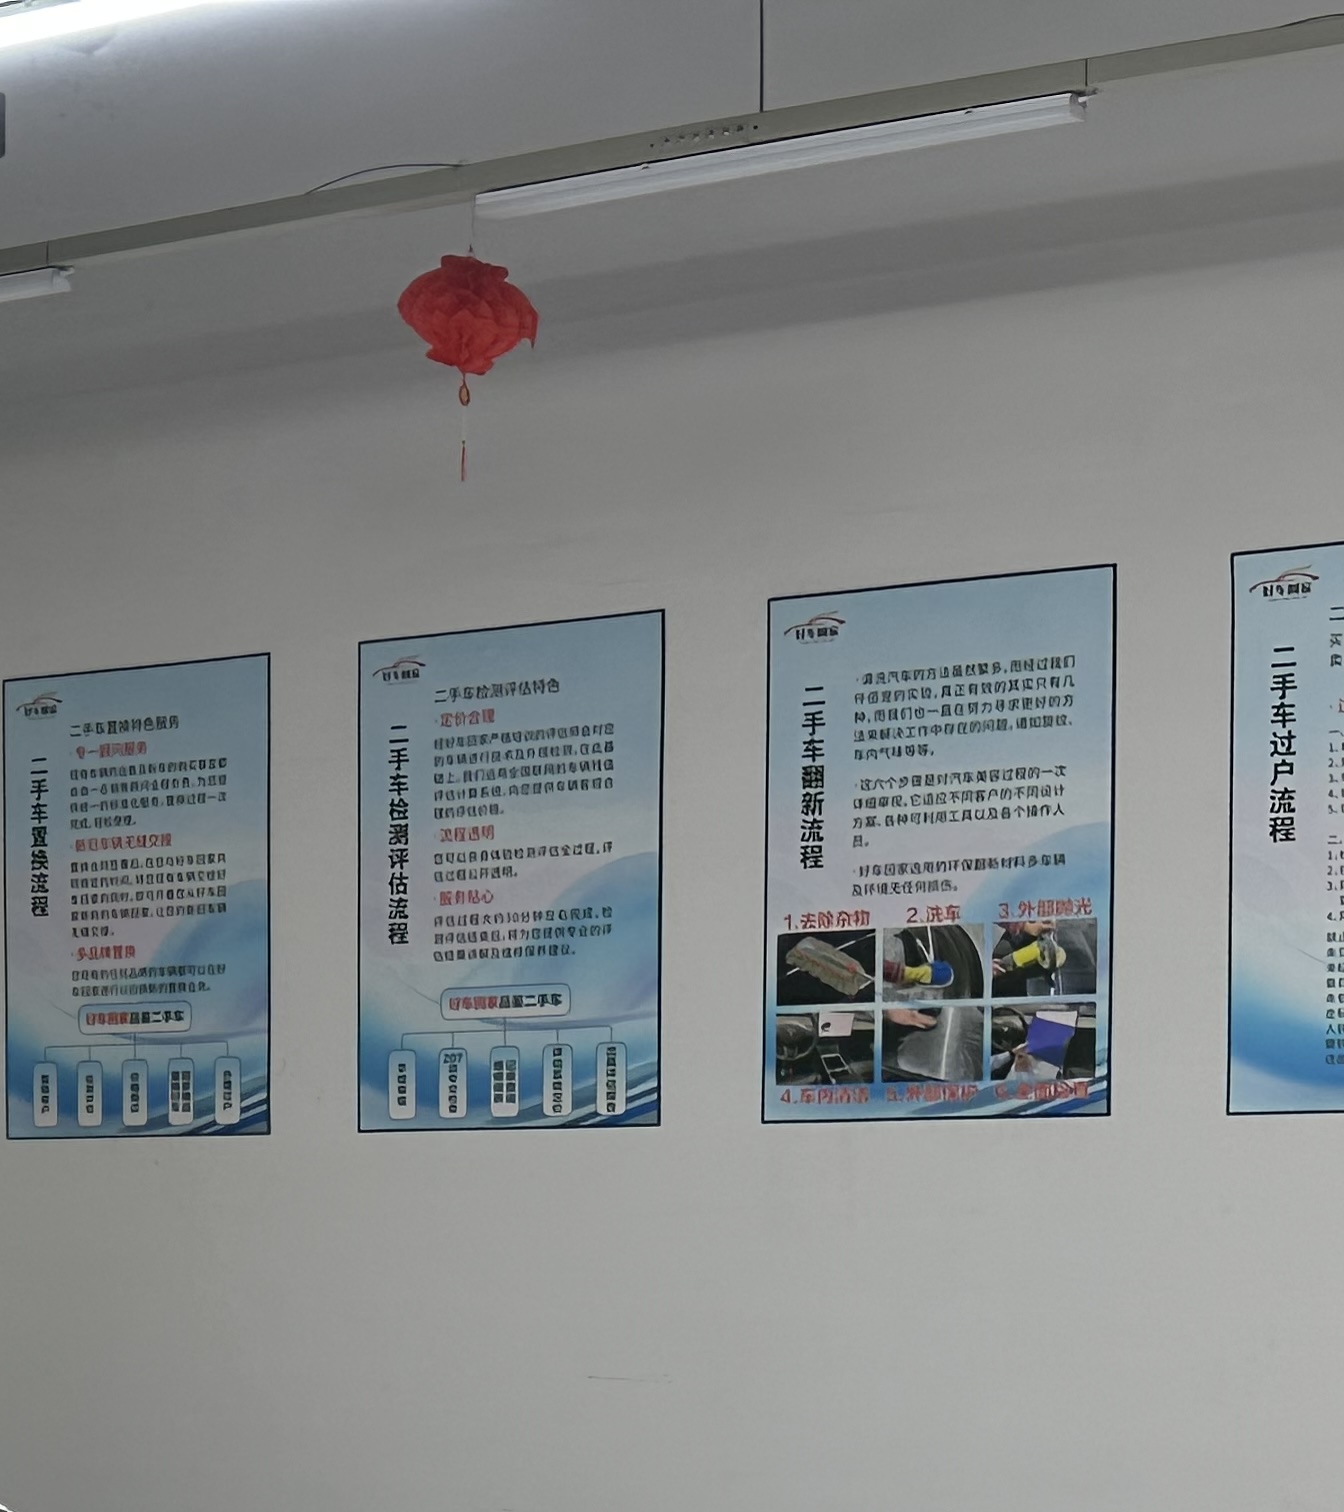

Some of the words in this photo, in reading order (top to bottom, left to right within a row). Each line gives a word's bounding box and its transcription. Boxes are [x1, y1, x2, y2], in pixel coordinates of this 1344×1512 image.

[388, 724, 410, 946] 二手车检测评估流程
[800, 687, 826, 869] 二手车翻新流程
[1268, 646, 1296, 843] 二手车过户流程
